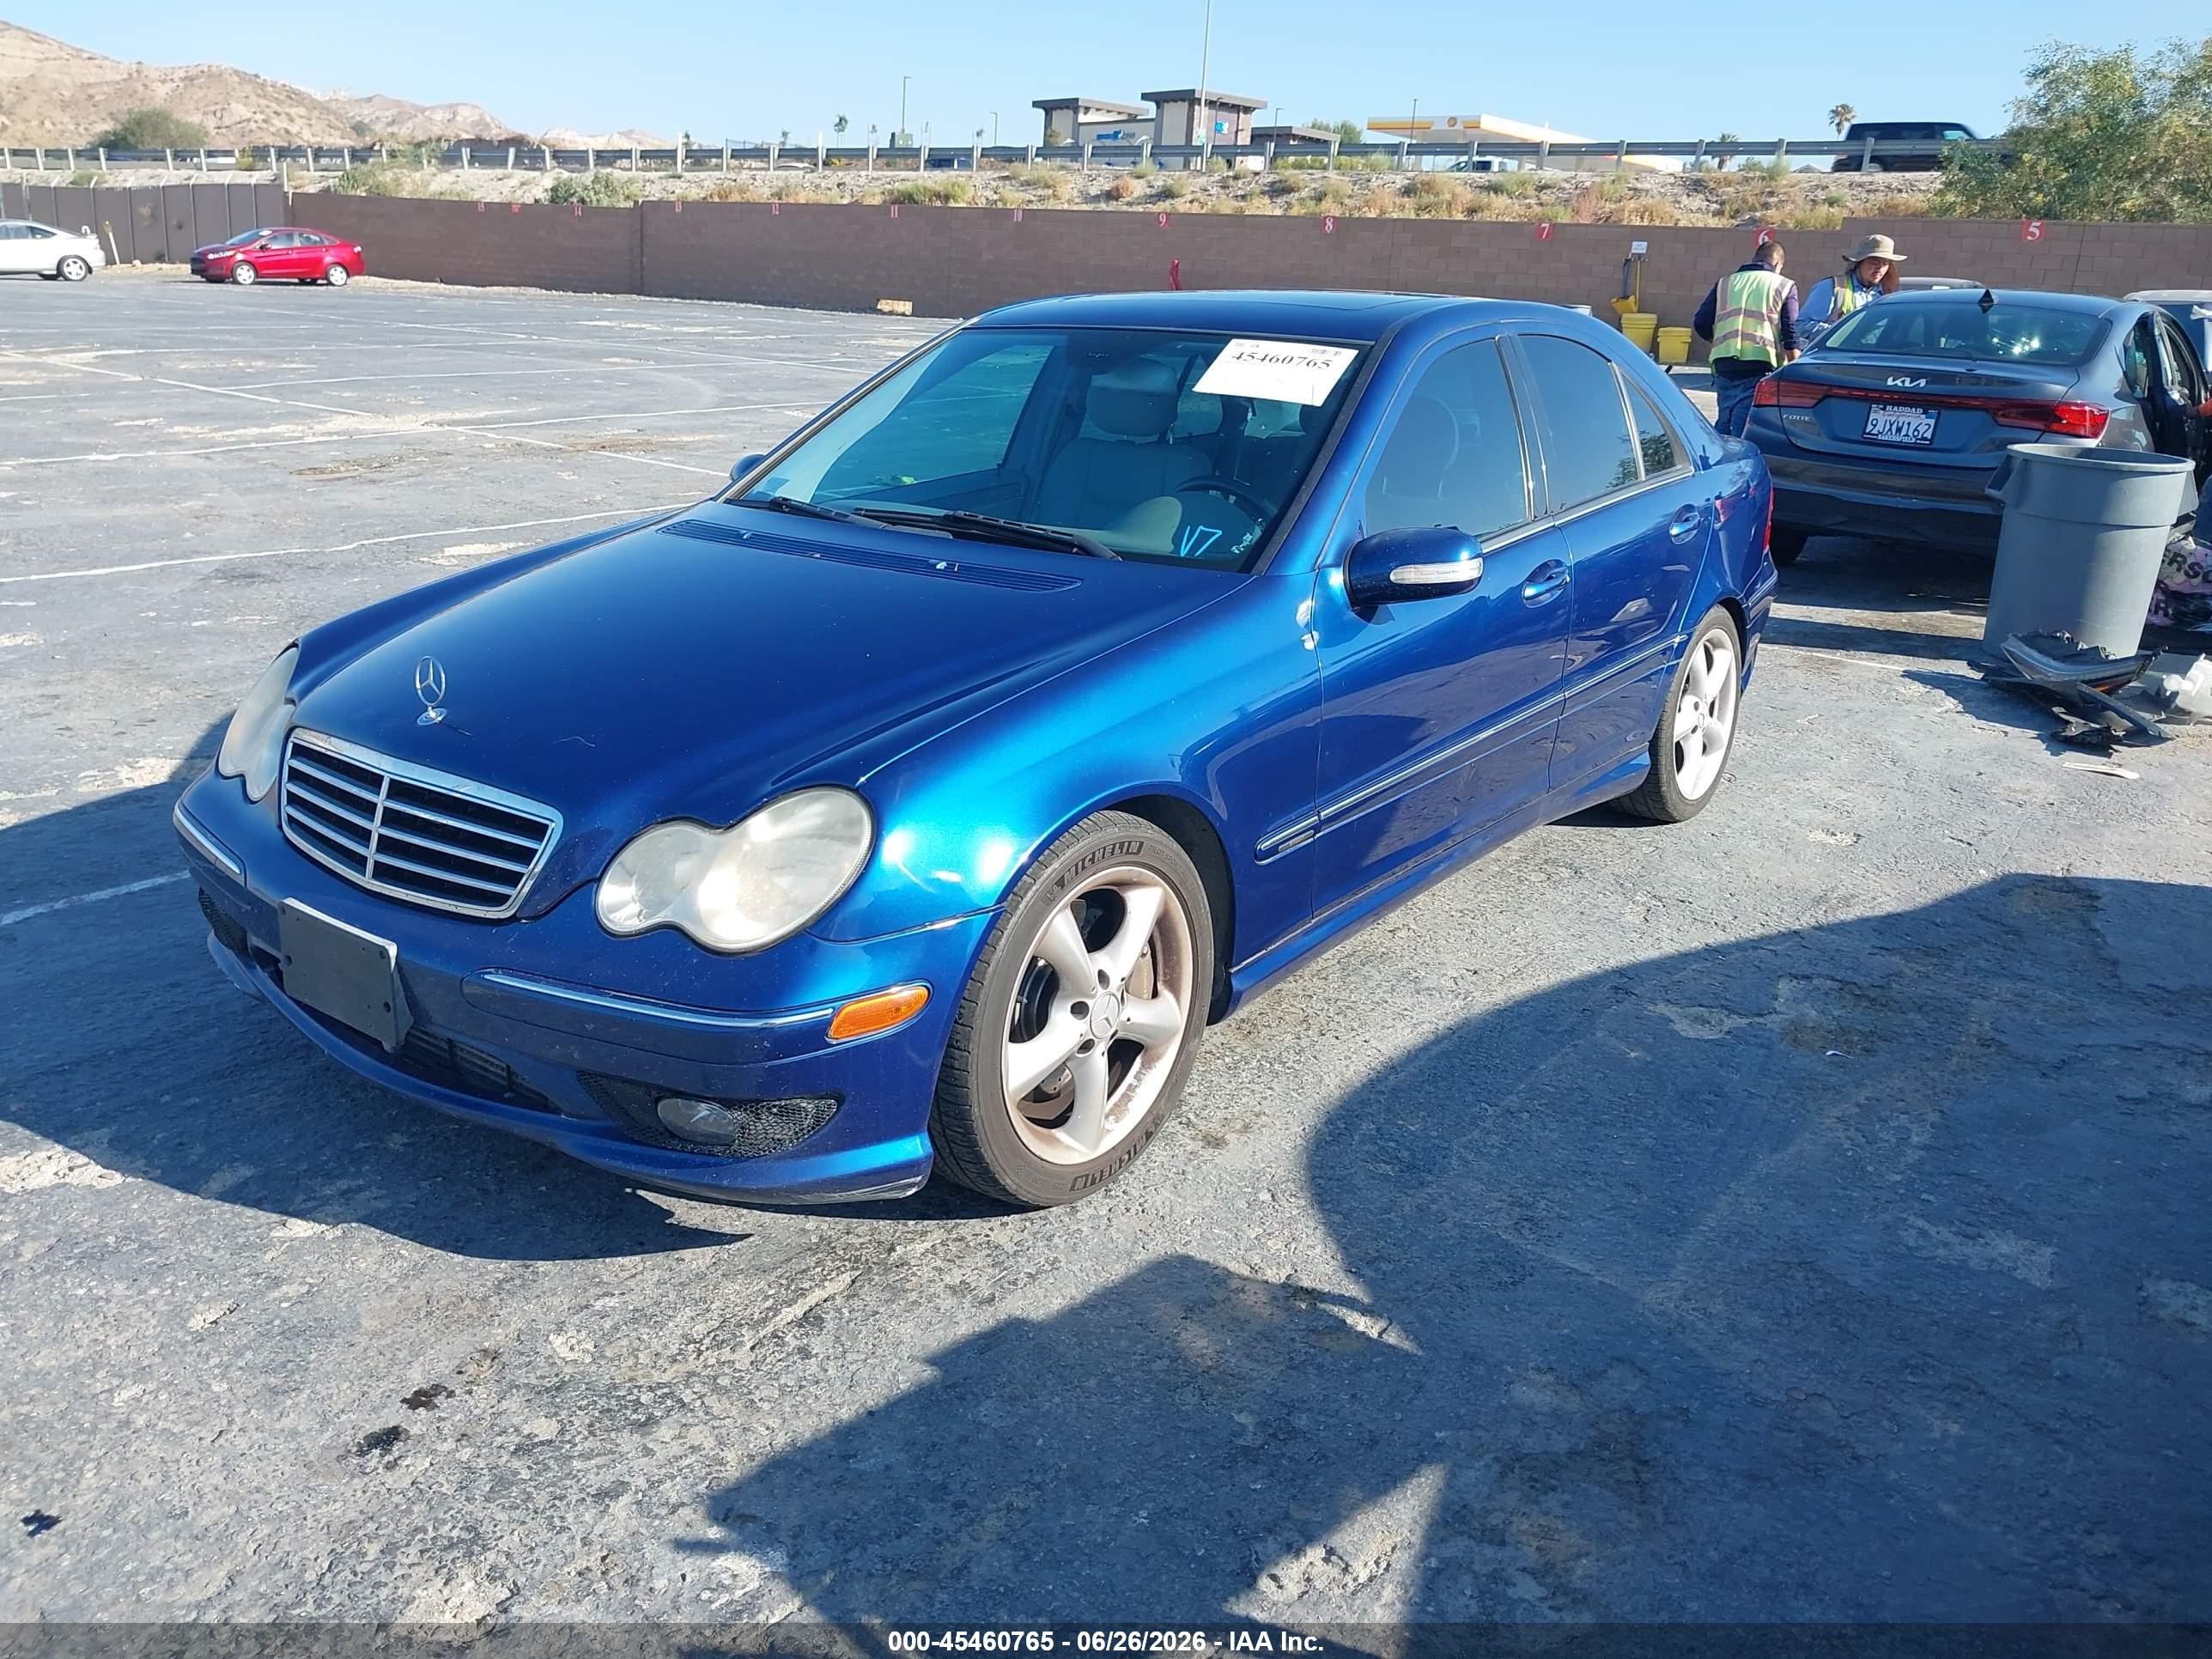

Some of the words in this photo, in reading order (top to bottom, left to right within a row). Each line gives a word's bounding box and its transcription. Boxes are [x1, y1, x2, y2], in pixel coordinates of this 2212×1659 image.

[1158, 213, 1167, 228] 9
[1325, 216, 1334, 234] 8
[1540, 222, 1550, 240] 7
[2027, 222, 2042, 240] 5
[1231, 350, 1334, 370] 45460765
[1886, 376, 1927, 388] KIA
[1885, 404, 1923, 415] HADDAD
[1868, 416, 1933, 439] 9JXW162
[1062, 840, 1144, 884] MICHELIN
[1071, 1132, 1151, 1191] MICHELIN
